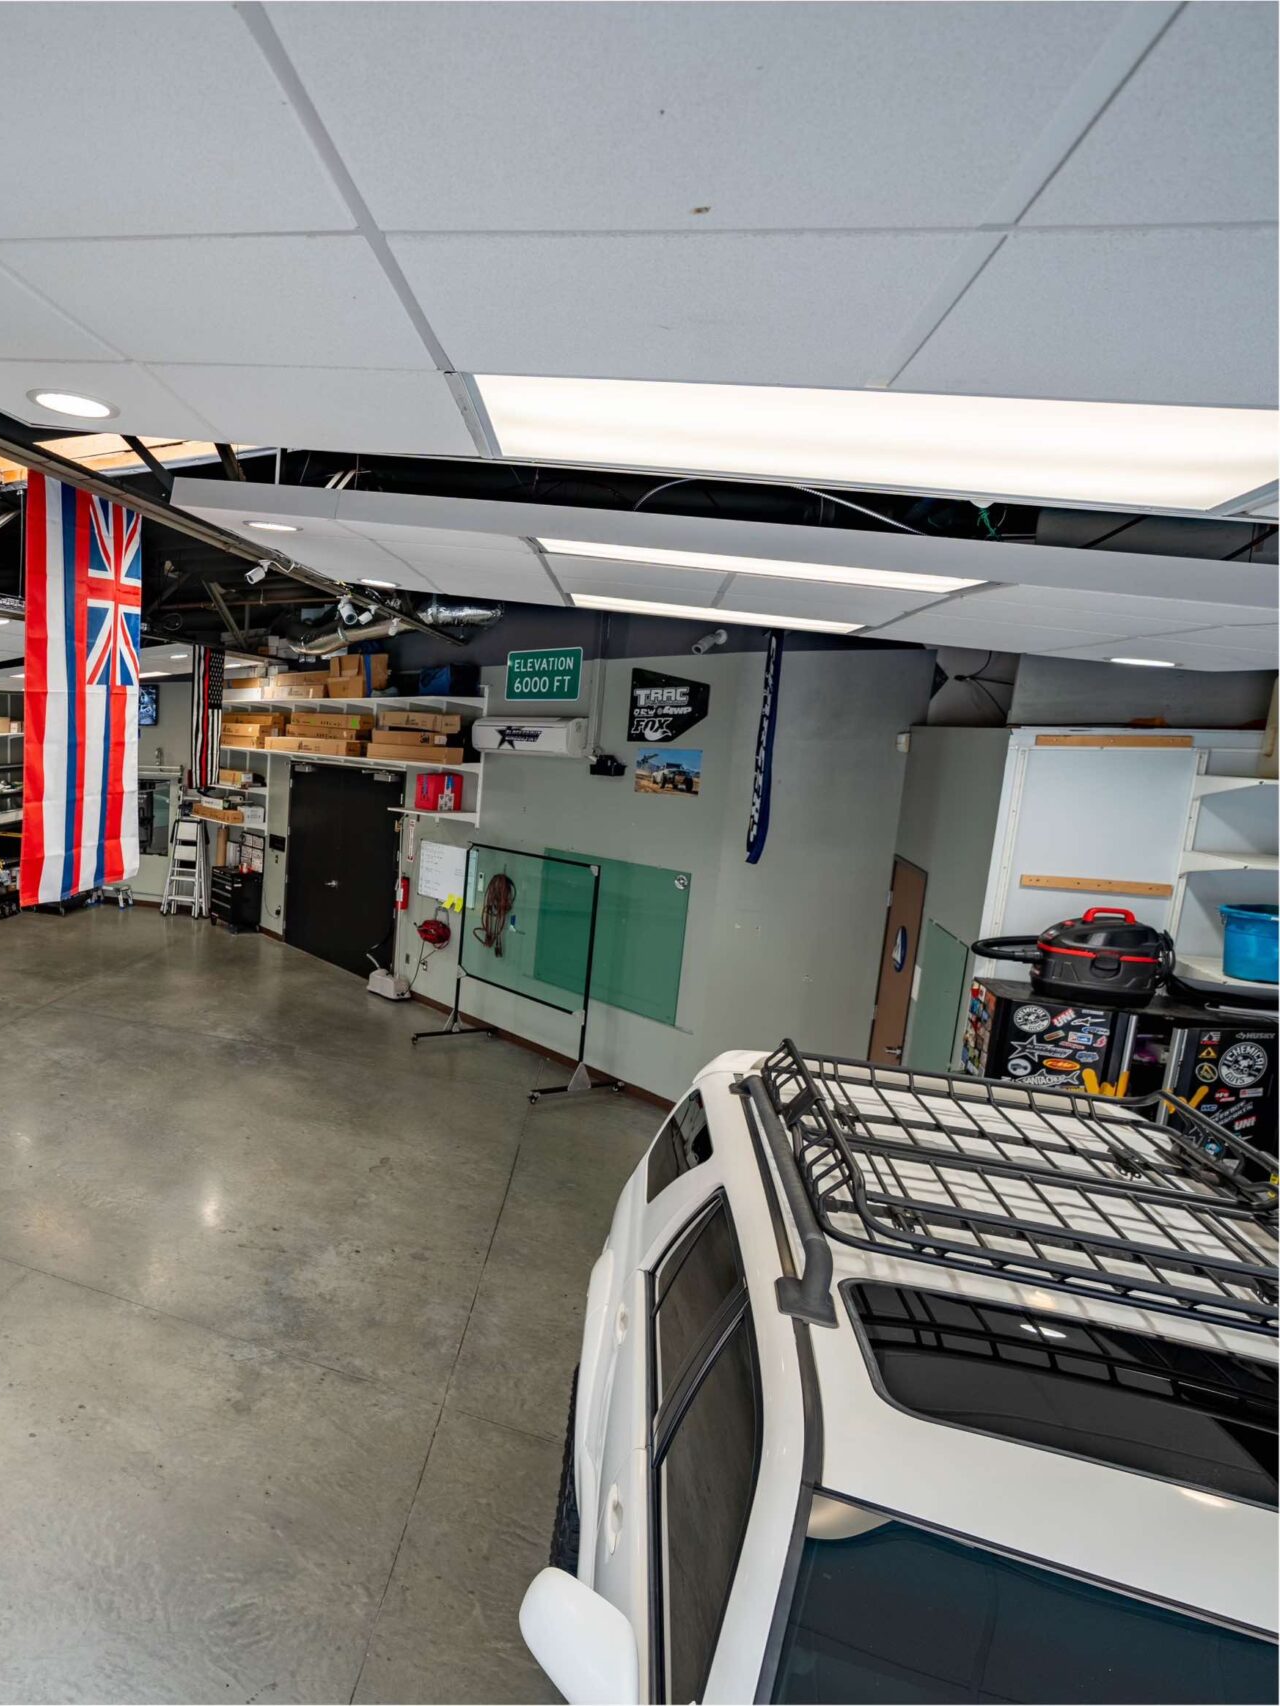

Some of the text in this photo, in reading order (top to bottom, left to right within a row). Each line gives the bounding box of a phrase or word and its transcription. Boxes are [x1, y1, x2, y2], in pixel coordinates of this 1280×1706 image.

[513, 656, 574, 672] ELEVATION
[513, 676, 572, 692] 6000 FT
[634, 687, 690, 707] TRAC
[631, 717, 674, 740] FOX
[1226, 1045, 1265, 1069] CHEMICAL
